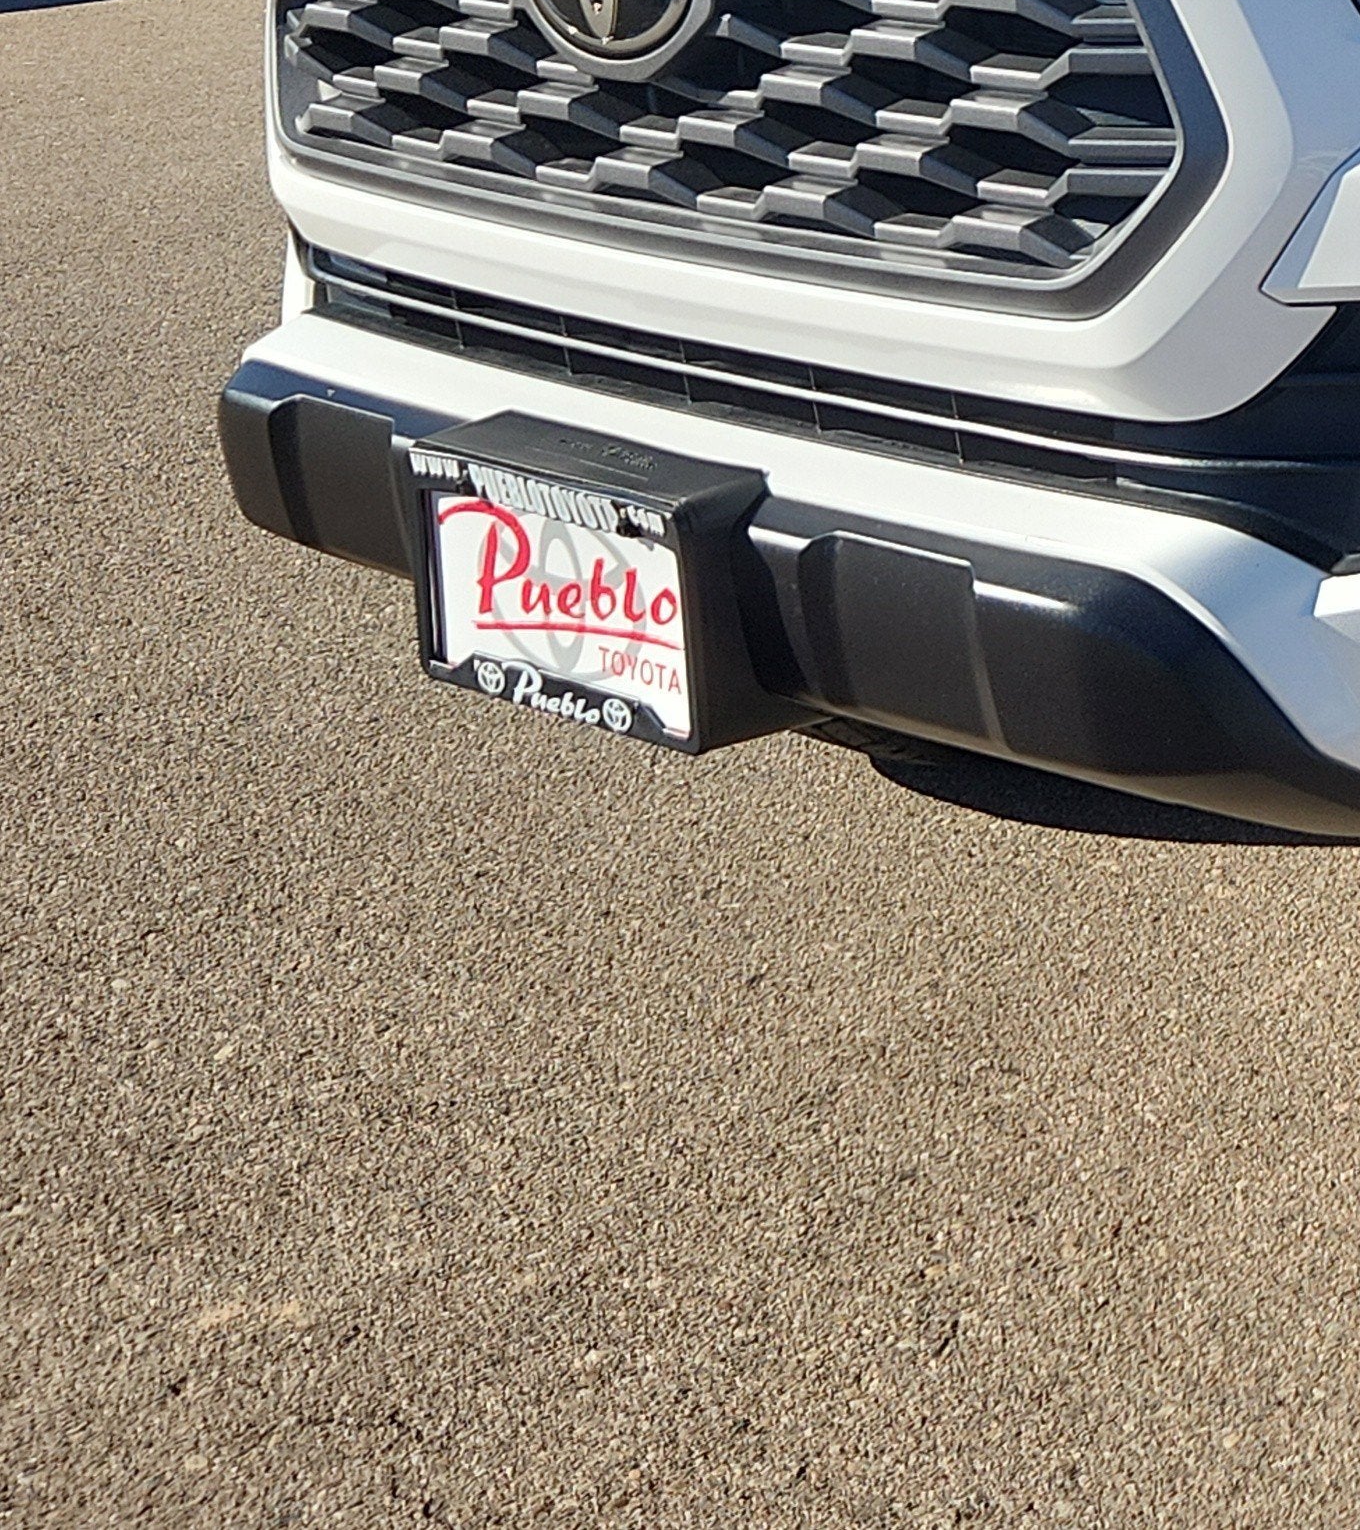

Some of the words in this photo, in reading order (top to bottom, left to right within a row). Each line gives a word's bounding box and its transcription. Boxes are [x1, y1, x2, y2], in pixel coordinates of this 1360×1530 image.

[438, 500, 678, 625] Pueblo
[502, 660, 601, 724] Pueblo
[598, 646, 682, 695] TOYOTA
